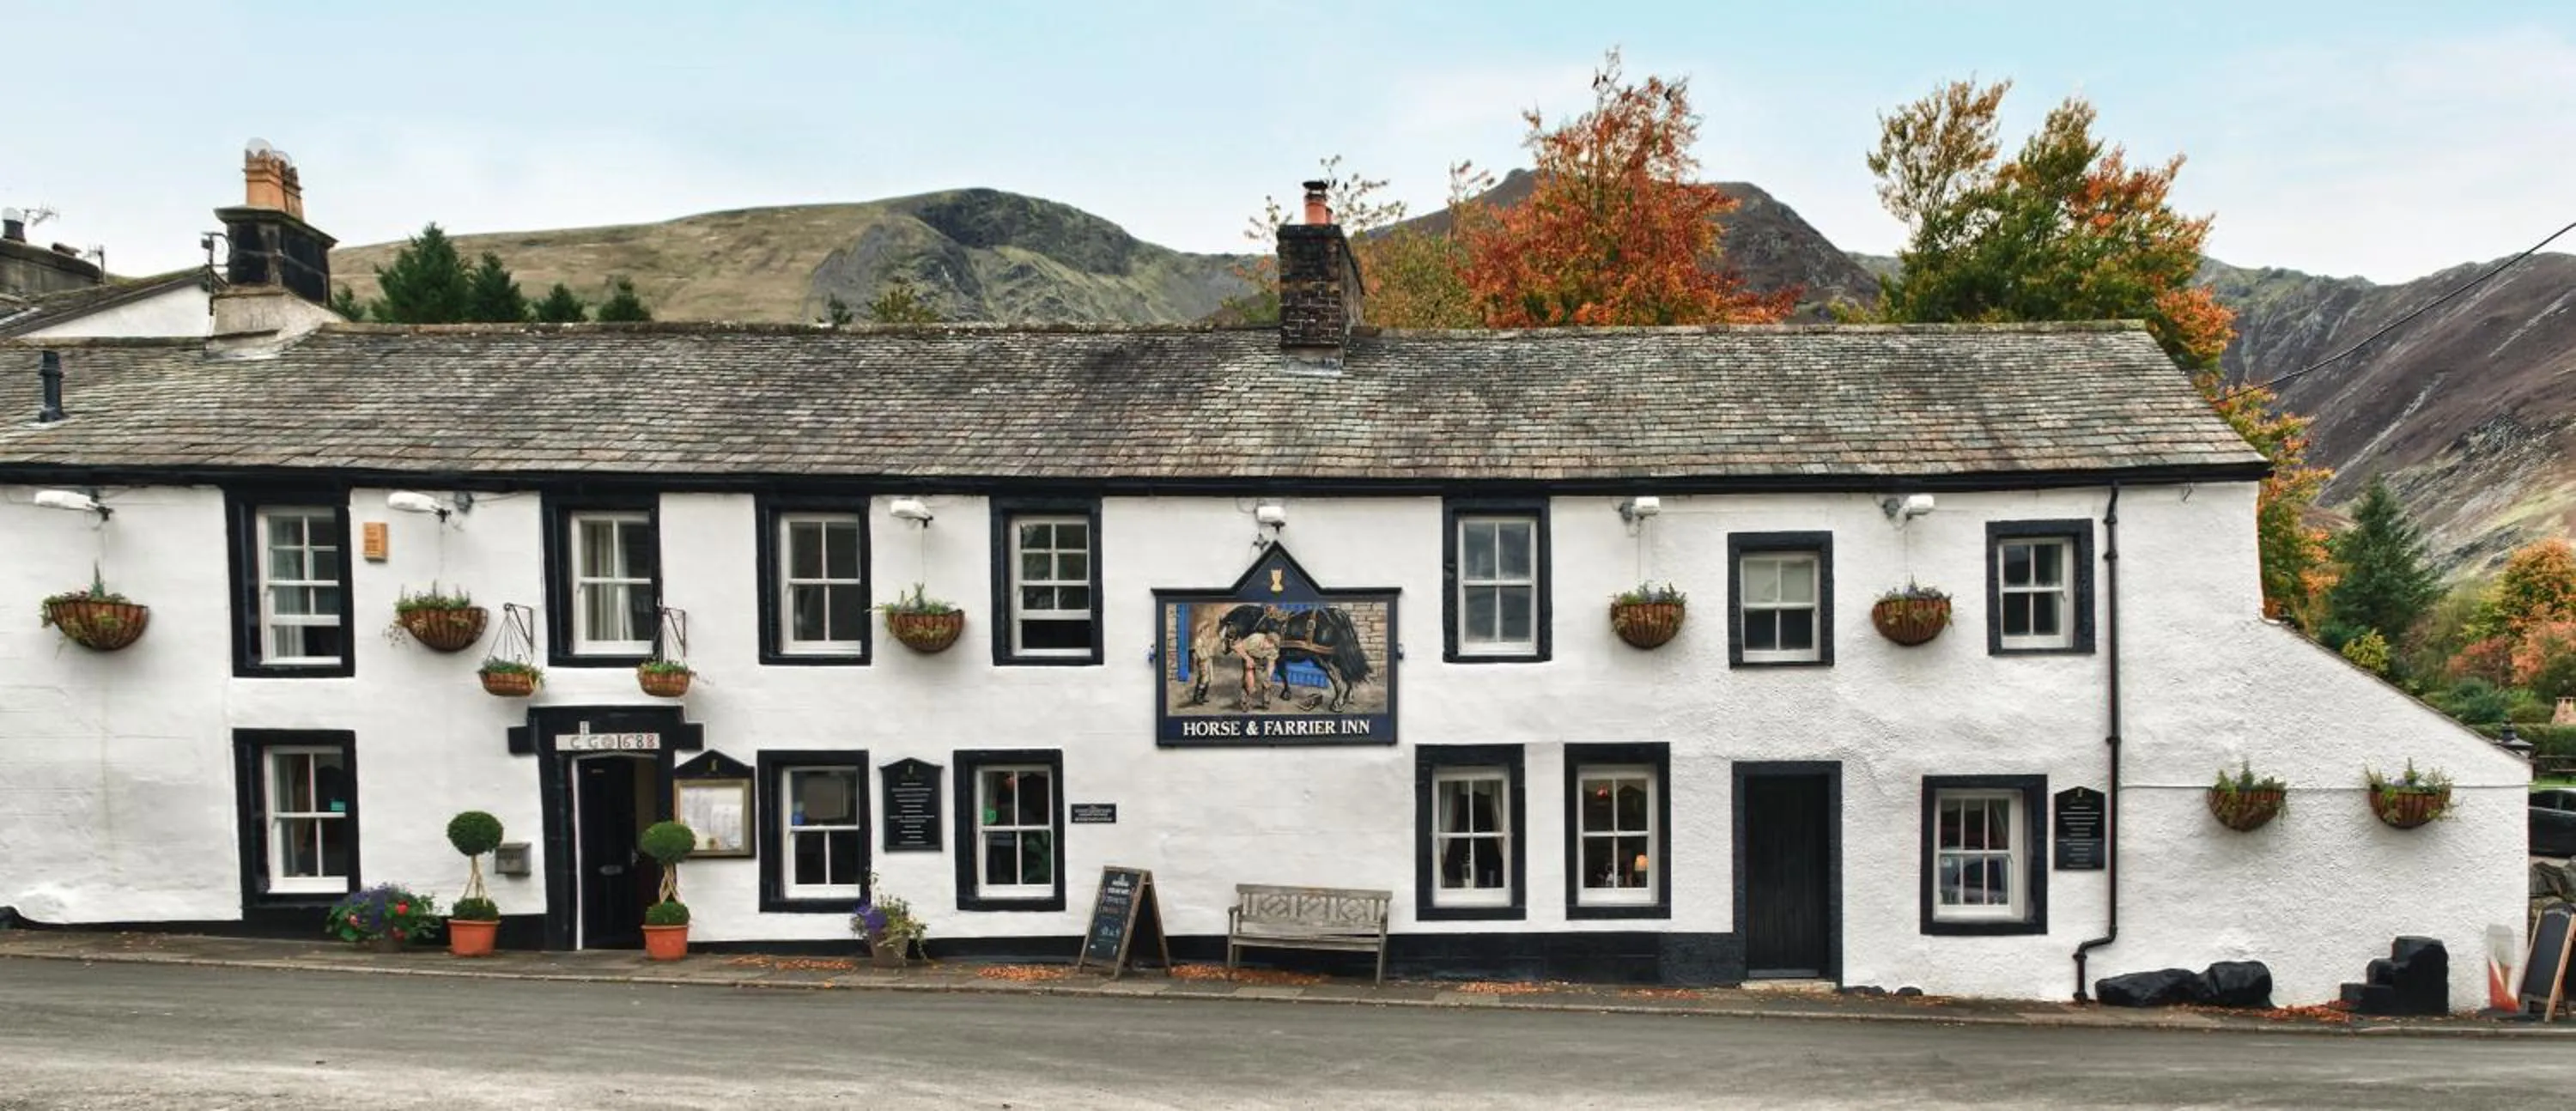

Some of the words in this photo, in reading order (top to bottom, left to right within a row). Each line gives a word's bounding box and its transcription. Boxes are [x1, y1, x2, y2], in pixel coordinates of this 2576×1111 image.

[1183, 720, 1241, 737] HORSE
[1246, 719, 1259, 737] &
[1264, 719, 1337, 736] FARRIER
[1341, 719, 1370, 735] INN
[617, 733, 655, 749] 1688
